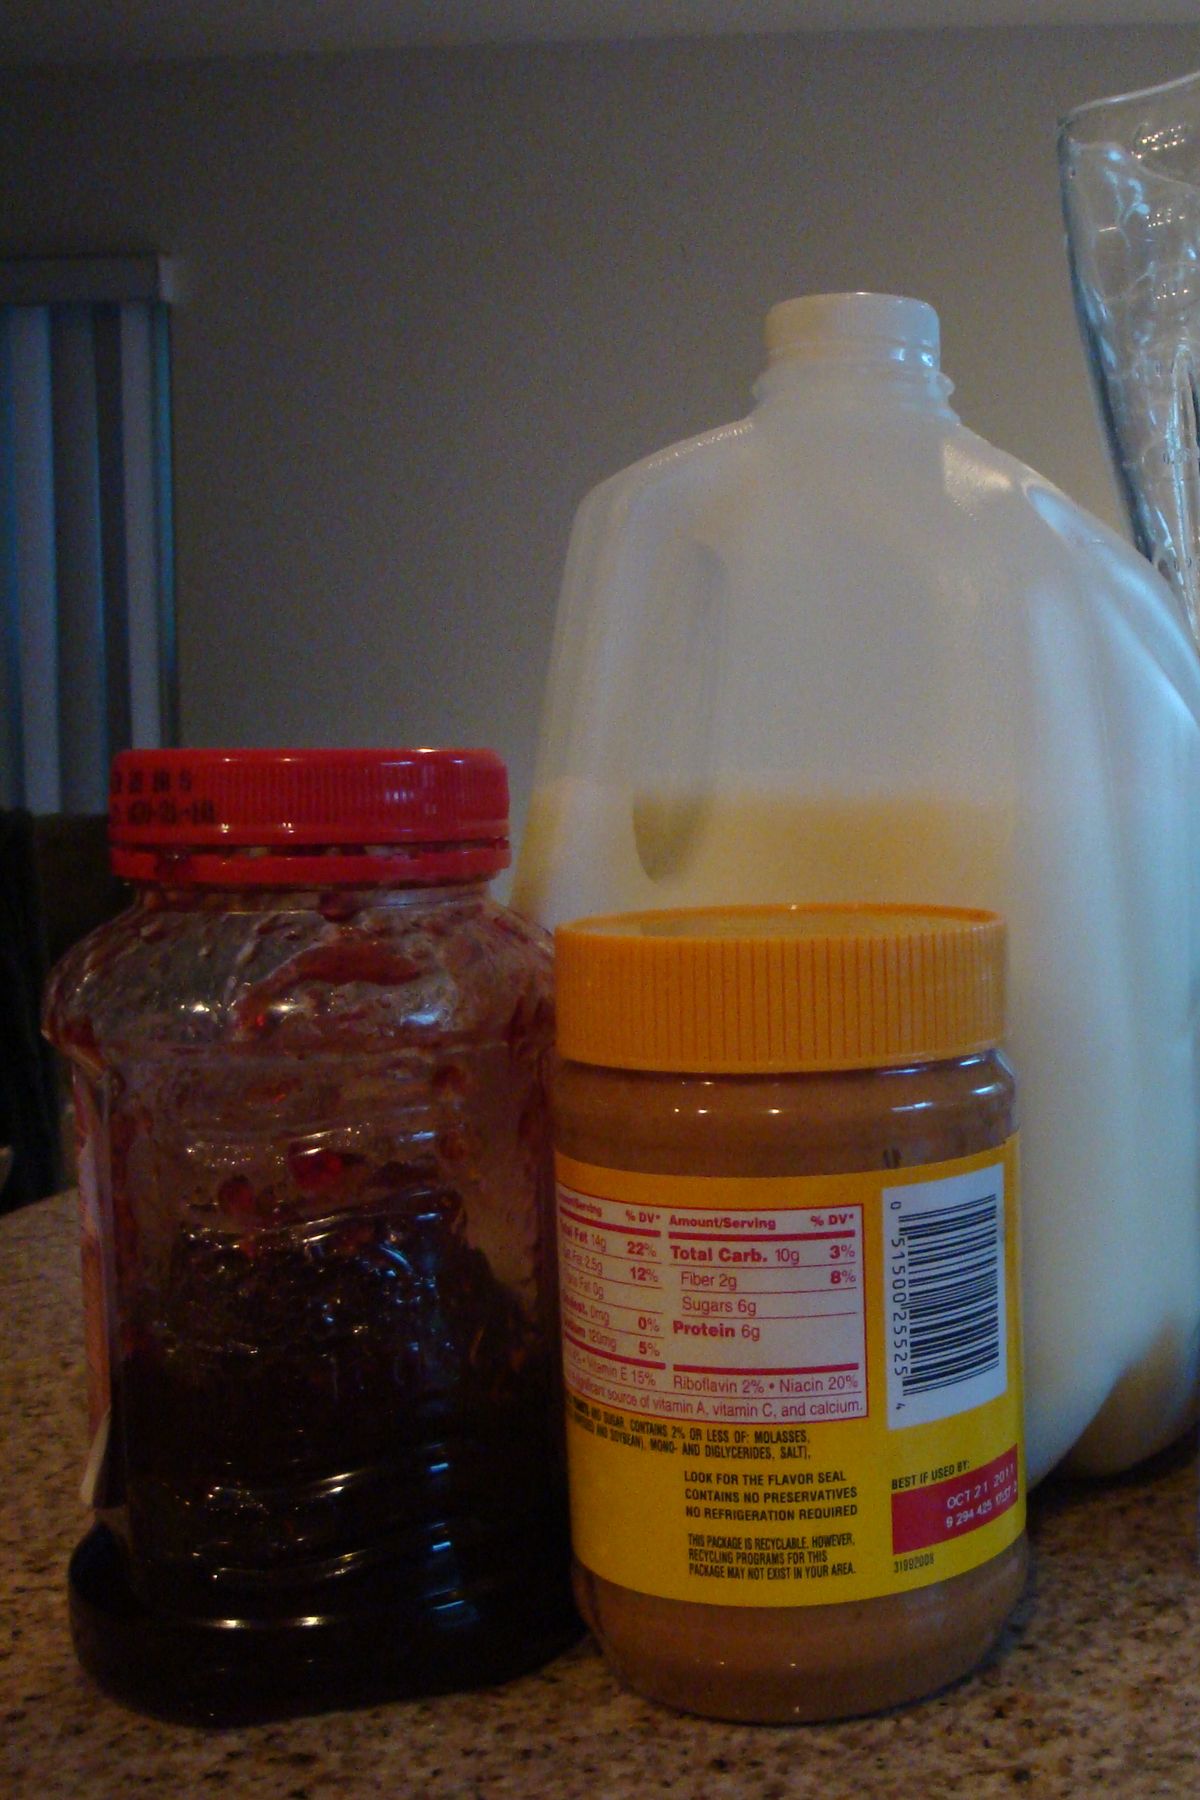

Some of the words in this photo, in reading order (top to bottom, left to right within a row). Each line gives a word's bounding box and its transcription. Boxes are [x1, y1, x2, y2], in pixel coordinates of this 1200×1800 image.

[889, 1201, 902, 1211] 0
[669, 1213, 777, 1230] Amount/Serving
[626, 1240, 657, 1257] 22%
[670, 1245, 714, 1262] Total
[718, 1247, 768, 1263] Carb.
[774, 1248, 801, 1266] 10g
[829, 1244, 856, 1260] 3%
[630, 1266, 659, 1283] 12%
[681, 1271, 715, 1286] Fiber
[719, 1272, 738, 1290] 2g
[829, 1269, 857, 1285] 8%
[891, 1238, 907, 1304] 51500
[682, 1296, 733, 1315] Sugars
[737, 1298, 757, 1316] 6g
[638, 1316, 660, 1333] 0%
[672, 1320, 736, 1338] Protein
[741, 1323, 761, 1342] 6g
[638, 1340, 661, 1357] 5%
[893, 1311, 909, 1376] 25525
[631, 1369, 657, 1387] 15%
[673, 1375, 738, 1393] Riboflavin
[741, 1378, 766, 1394] 2%
[779, 1378, 824, 1393] Niacin
[828, 1374, 859, 1391] 20%
[652, 1396, 694, 1415] vitamin
[712, 1403, 758, 1418] vitamin
[781, 1402, 807, 1417] and
[809, 1399, 863, 1416] calcium.
[630, 1418, 668, 1438] CONTAINS
[706, 1428, 730, 1442] LESS
[682, 1443, 701, 1457] AND
[684, 1470, 713, 1484] LOOK
[716, 1472, 739, 1486] FOR
[742, 1473, 764, 1486] THE
[768, 1471, 814, 1486] FLAVOR
[817, 1470, 846, 1483] SEAL
[891, 1475, 917, 1490] BEST
[920, 1471, 929, 1484] IF
[931, 1464, 955, 1481] USED
[685, 1488, 740, 1504] CONTAINS
[743, 1491, 760, 1504] NO
[763, 1486, 858, 1504] PRESERVATIVES
[946, 1489, 971, 1510] OCT
[974, 1480, 988, 1499] 21
[686, 1506, 701, 1519] NO
[704, 1507, 795, 1522] REFRIGERATION
[799, 1504, 858, 1521] REQUIRED
[687, 1532, 705, 1547] THIS
[707, 1535, 742, 1551] PACKAGE
[688, 1548, 734, 1564] RECYCLING
[736, 1551, 785, 1566] PROGRAMS
[787, 1551, 805, 1565] FOR
[807, 1550, 828, 1563] THIS
[688, 1562, 726, 1579] PACKAGE
[727, 1566, 746, 1580] MAY
[747, 1567, 765, 1580] NOT
[767, 1567, 791, 1581] EXIST
[793, 1567, 803, 1580] IN
[805, 1565, 829, 1579] YOUR
[831, 1562, 857, 1576] AREA.
